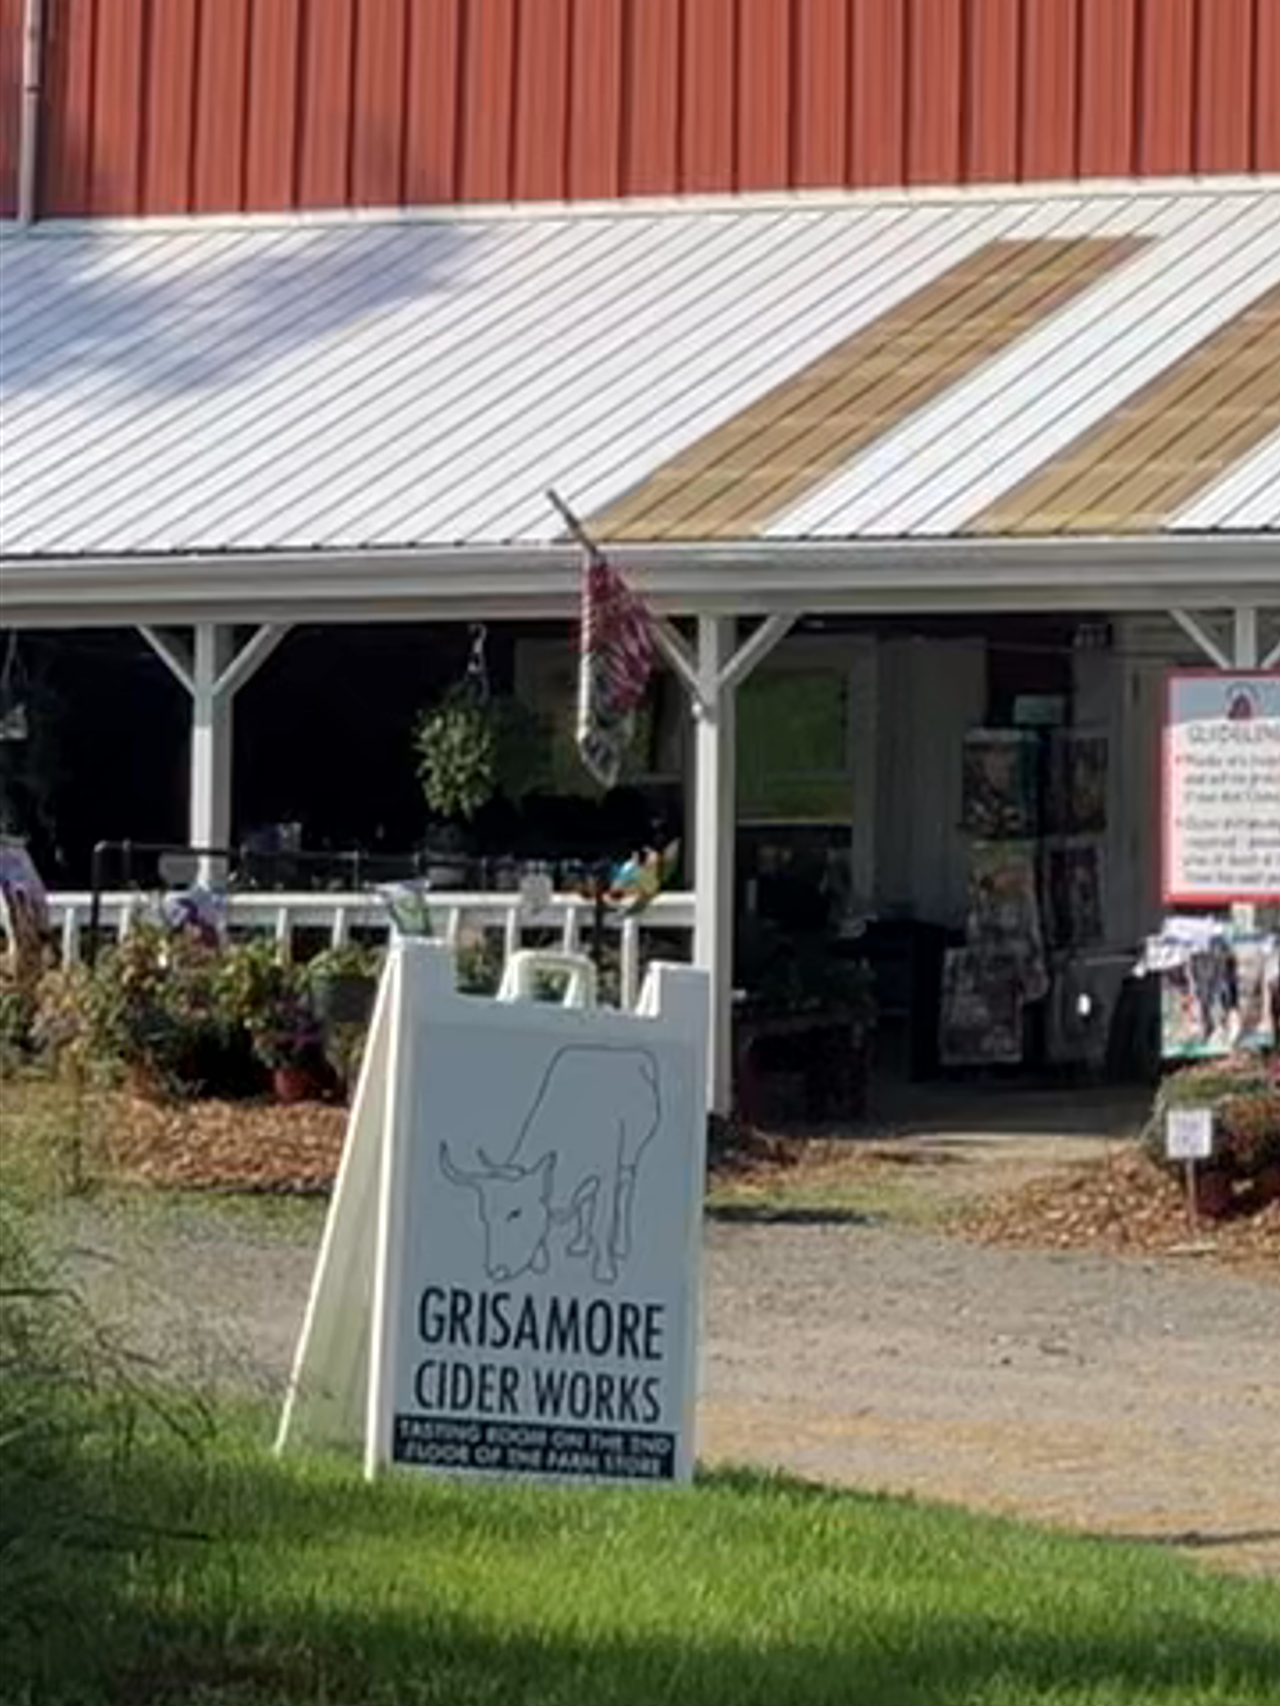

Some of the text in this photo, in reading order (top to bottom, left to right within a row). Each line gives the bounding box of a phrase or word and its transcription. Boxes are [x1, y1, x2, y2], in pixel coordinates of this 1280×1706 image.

[418, 1286, 665, 1361] GRISAMORE
[414, 1358, 661, 1424] CIDER WORKS
[399, 1420, 481, 1443] TASTING
[486, 1427, 546, 1445] ROOM
[552, 1431, 586, 1449] ON
[589, 1434, 625, 1452] THE
[405, 1441, 469, 1463] FLOOR
[475, 1445, 501, 1464] OF
[507, 1448, 541, 1466] THE
[546, 1451, 600, 1470] FARM
